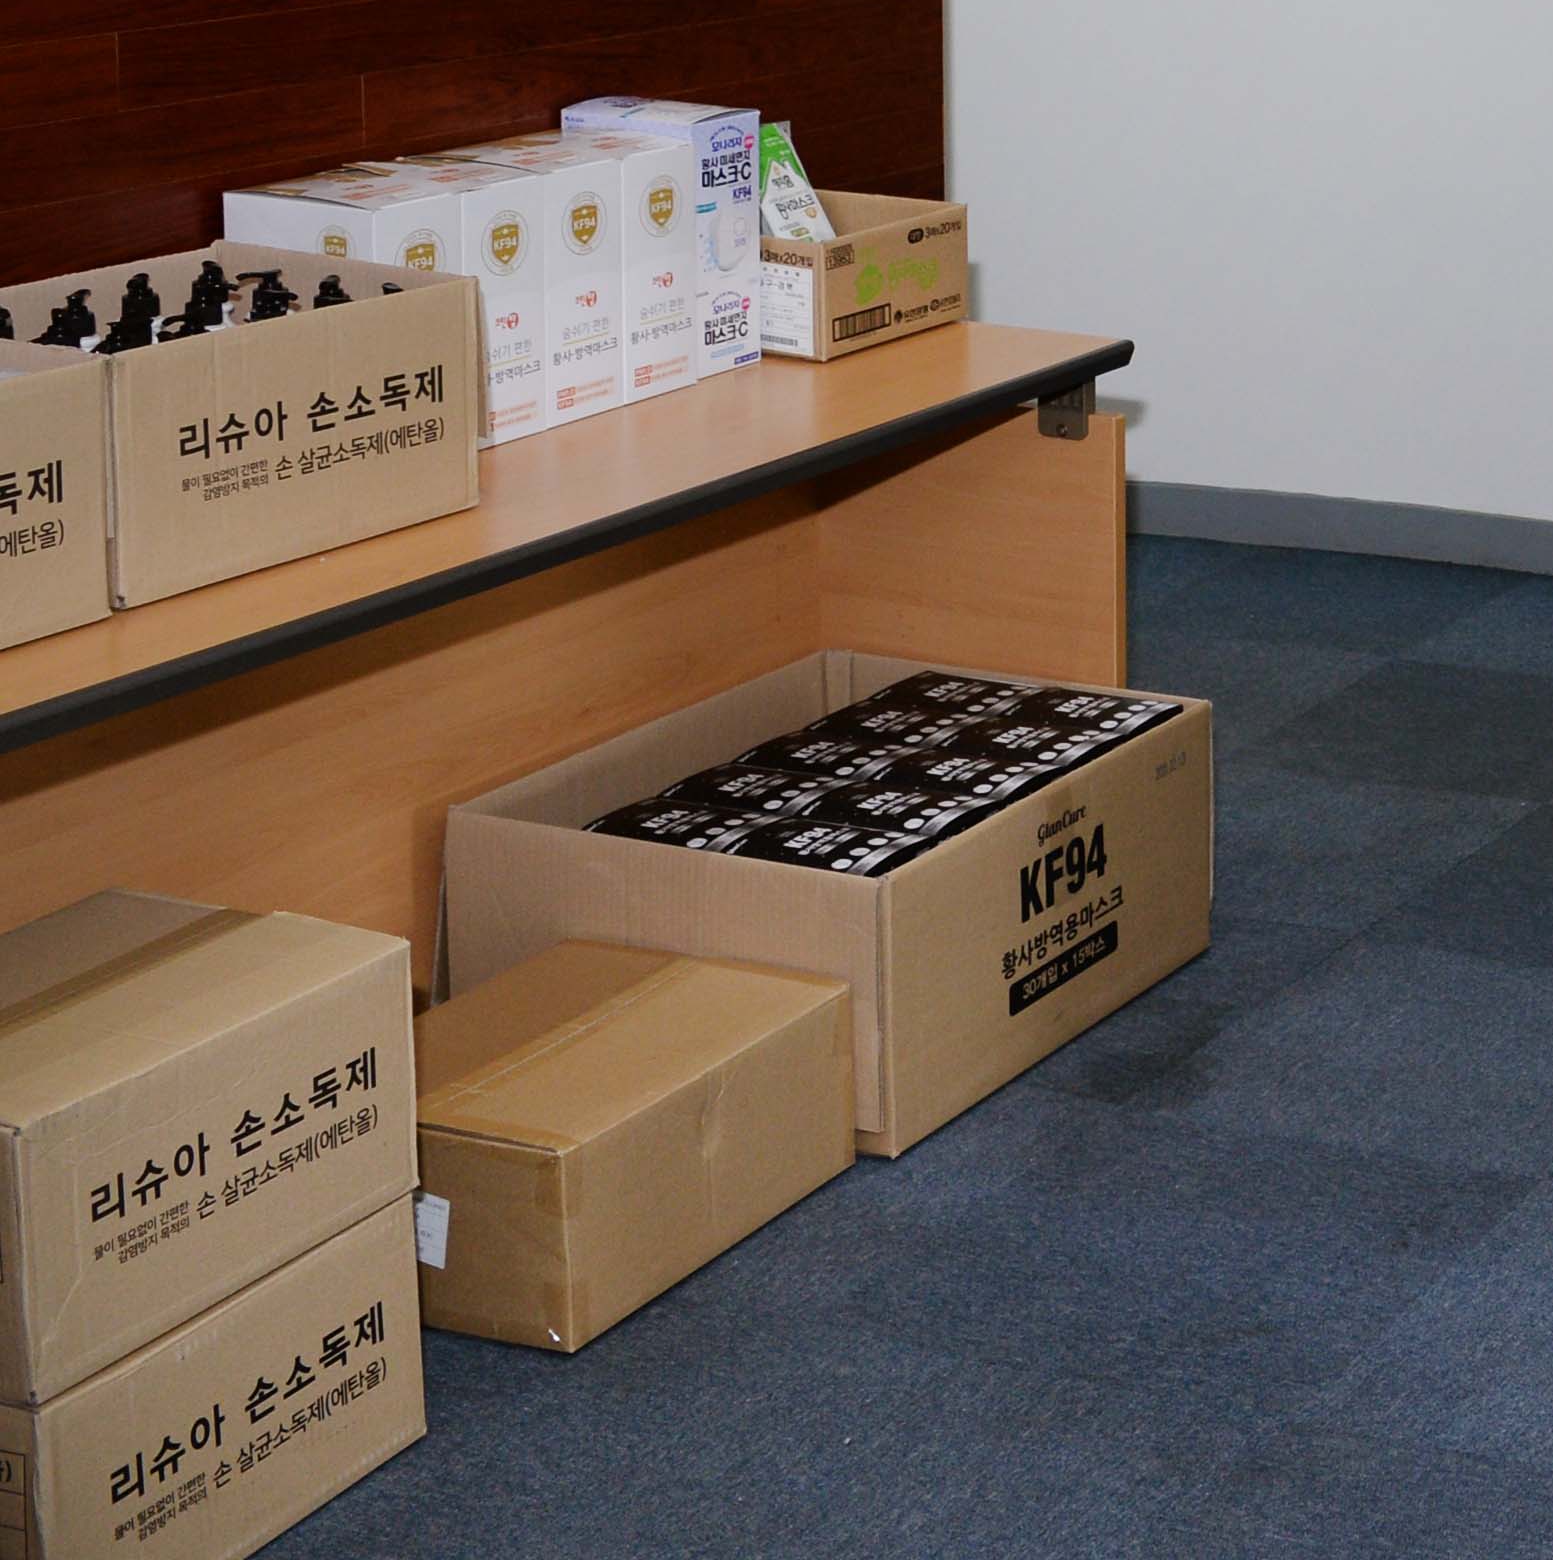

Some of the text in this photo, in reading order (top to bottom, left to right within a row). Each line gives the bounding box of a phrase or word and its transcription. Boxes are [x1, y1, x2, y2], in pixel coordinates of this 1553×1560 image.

[493, 237, 517, 251] KF94
[573, 218, 596, 231] KF94
[179, 401, 288, 459] 리슈아
[306, 364, 444, 433] 손소독제
[182, 459, 269, 492] 물이 필요없이 간편한
[275, 455, 294, 480] 손
[297, 416, 445, 474] 살균소독제(에탄올)
[203, 474, 269, 502] 감염방지 목적의
[1019, 824, 1107, 923] KF94
[1001, 885, 1124, 980] 황사방역용마스크
[1022, 963, 1059, 1000] 30개입
[90, 1047, 377, 1222] 리슈아 손소독제
[196, 1104, 378, 1219] 손 살균소독제(에탄올)
[94, 1200, 190, 1261] 물이 필요없이 간편한
[118, 1215, 190, 1264] 감염방지 목적의
[110, 1301, 384, 1505] 리슈아 손소독제
[212, 1357, 387, 1489] 손 살균소독제(에탄올)
